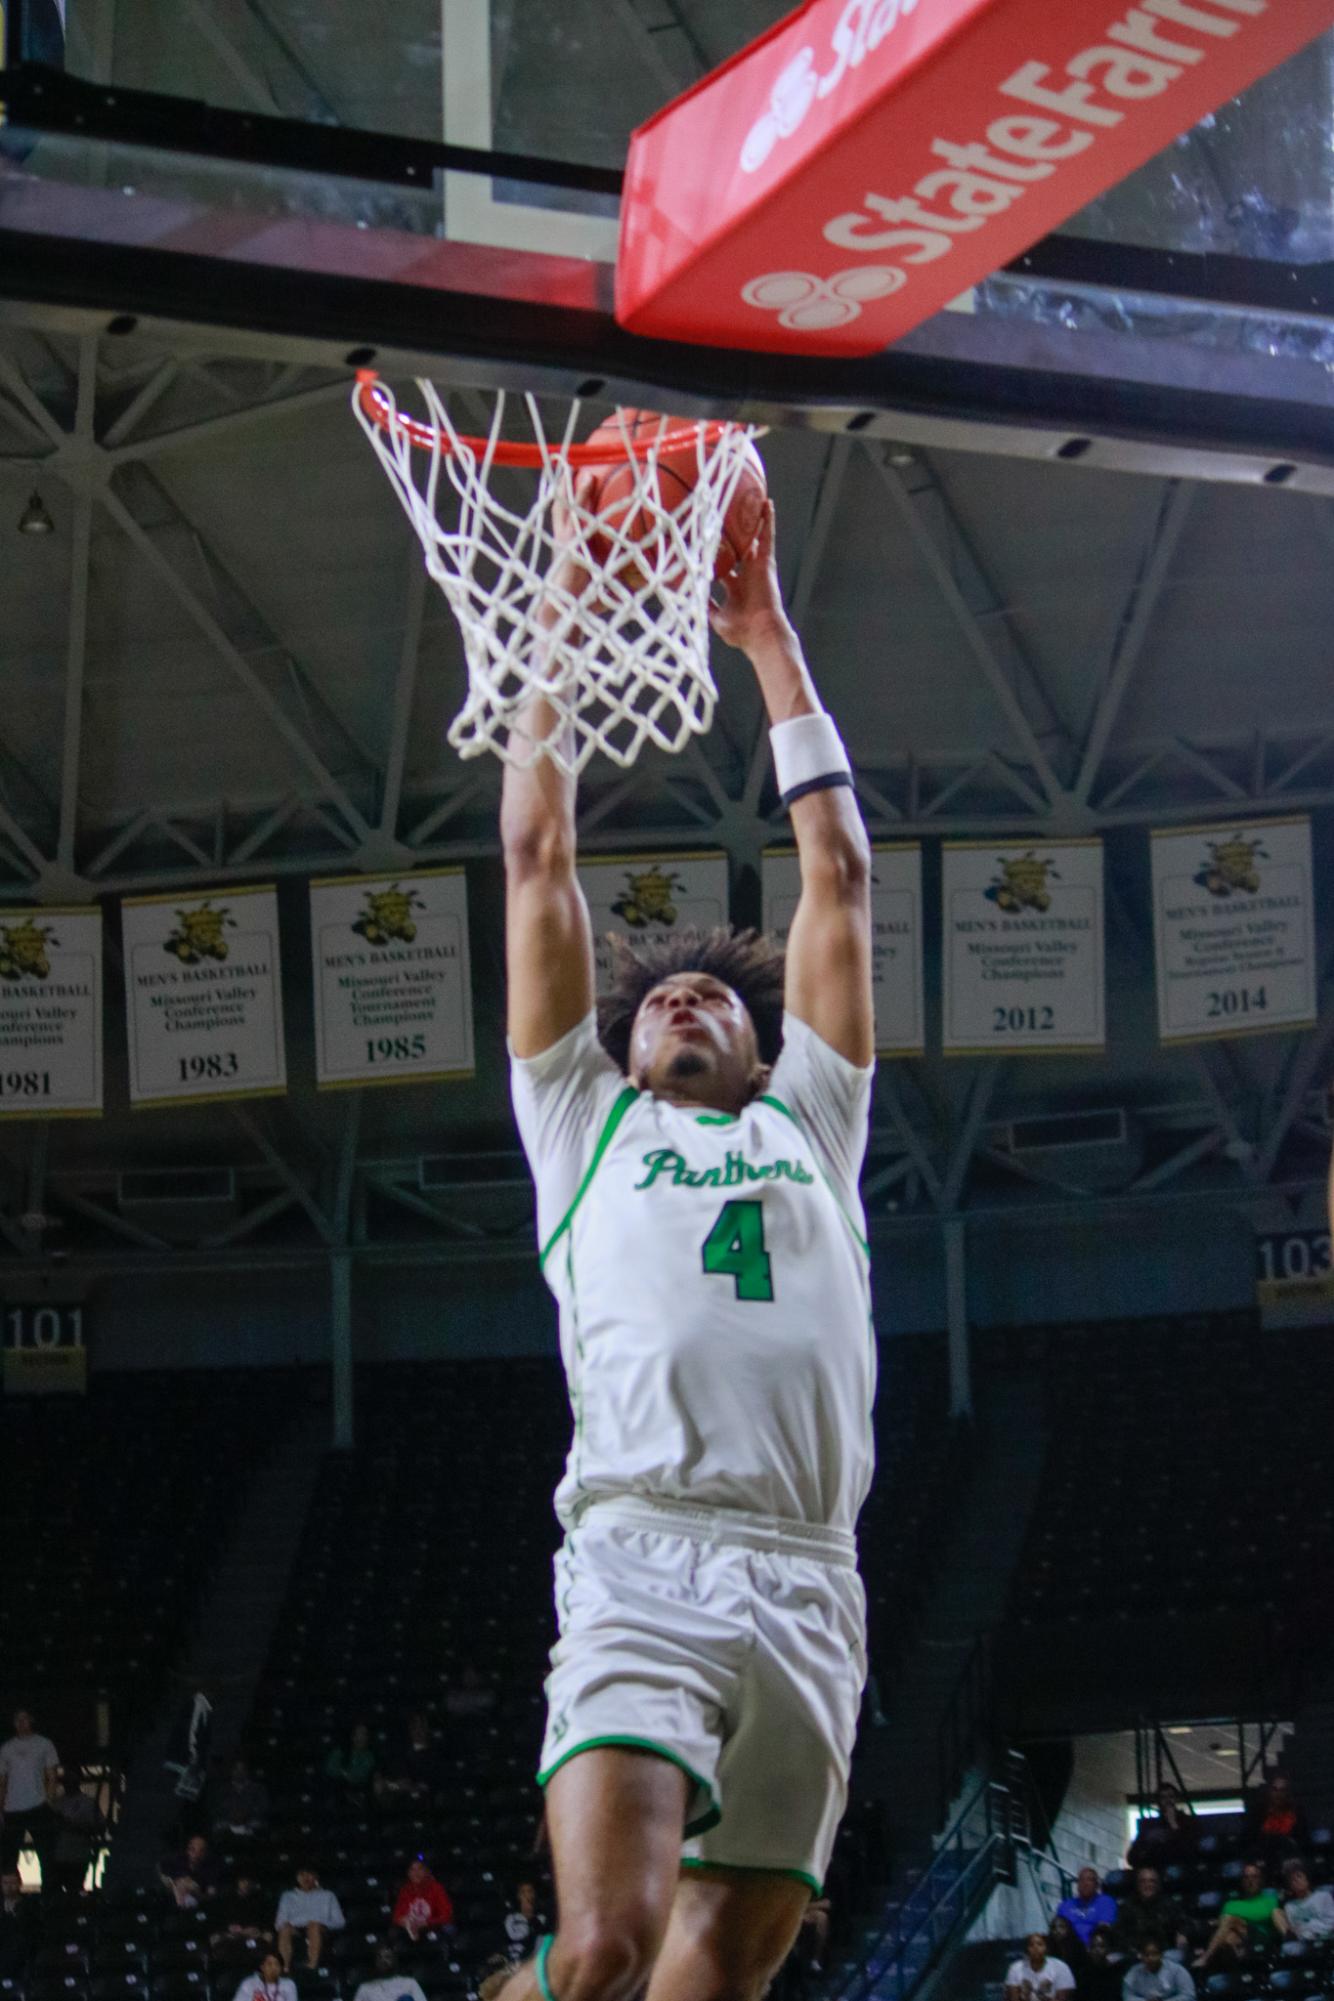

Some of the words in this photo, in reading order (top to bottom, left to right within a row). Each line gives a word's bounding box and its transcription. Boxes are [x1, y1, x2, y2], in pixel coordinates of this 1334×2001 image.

[1001, 917, 1090, 932] BASKETBALL
[325, 953, 366, 968] MEN'S
[369, 945, 457, 964] BASKETBALL
[967, 942, 1032, 955] Missouri
[1035, 940, 1078, 955] Valley
[980, 956, 1064, 967] Conference
[137, 972, 178, 987] MEN'S
[181, 963, 270, 982] BASKETBALL
[338, 973, 401, 988] Missouri
[404, 968, 446, 983] Valley
[980, 969, 1064, 983] Champions
[2, 983, 92, 999] BASKETBALL
[150, 989, 212, 1007] Missouri
[215, 986, 257, 1001] Valley
[351, 985, 432, 999] Conference
[1207, 985, 1268, 1017] 2014
[35, 1006, 77, 1022] Valley
[164, 1003, 244, 1018] Conference
[349, 997, 436, 1013] Tournament
[164, 1016, 246, 1032] Champions
[352, 1011, 434, 1026] Champions
[992, 1005, 1055, 1031] 2012
[367, 1034, 426, 1062] 1985
[180, 1052, 239, 1081] 1983
[634, 1149, 814, 1190] Panthers
[701, 1199, 775, 1302] 4
[1260, 1235, 1331, 1283] 103
[8, 1308, 83, 1349] 101
